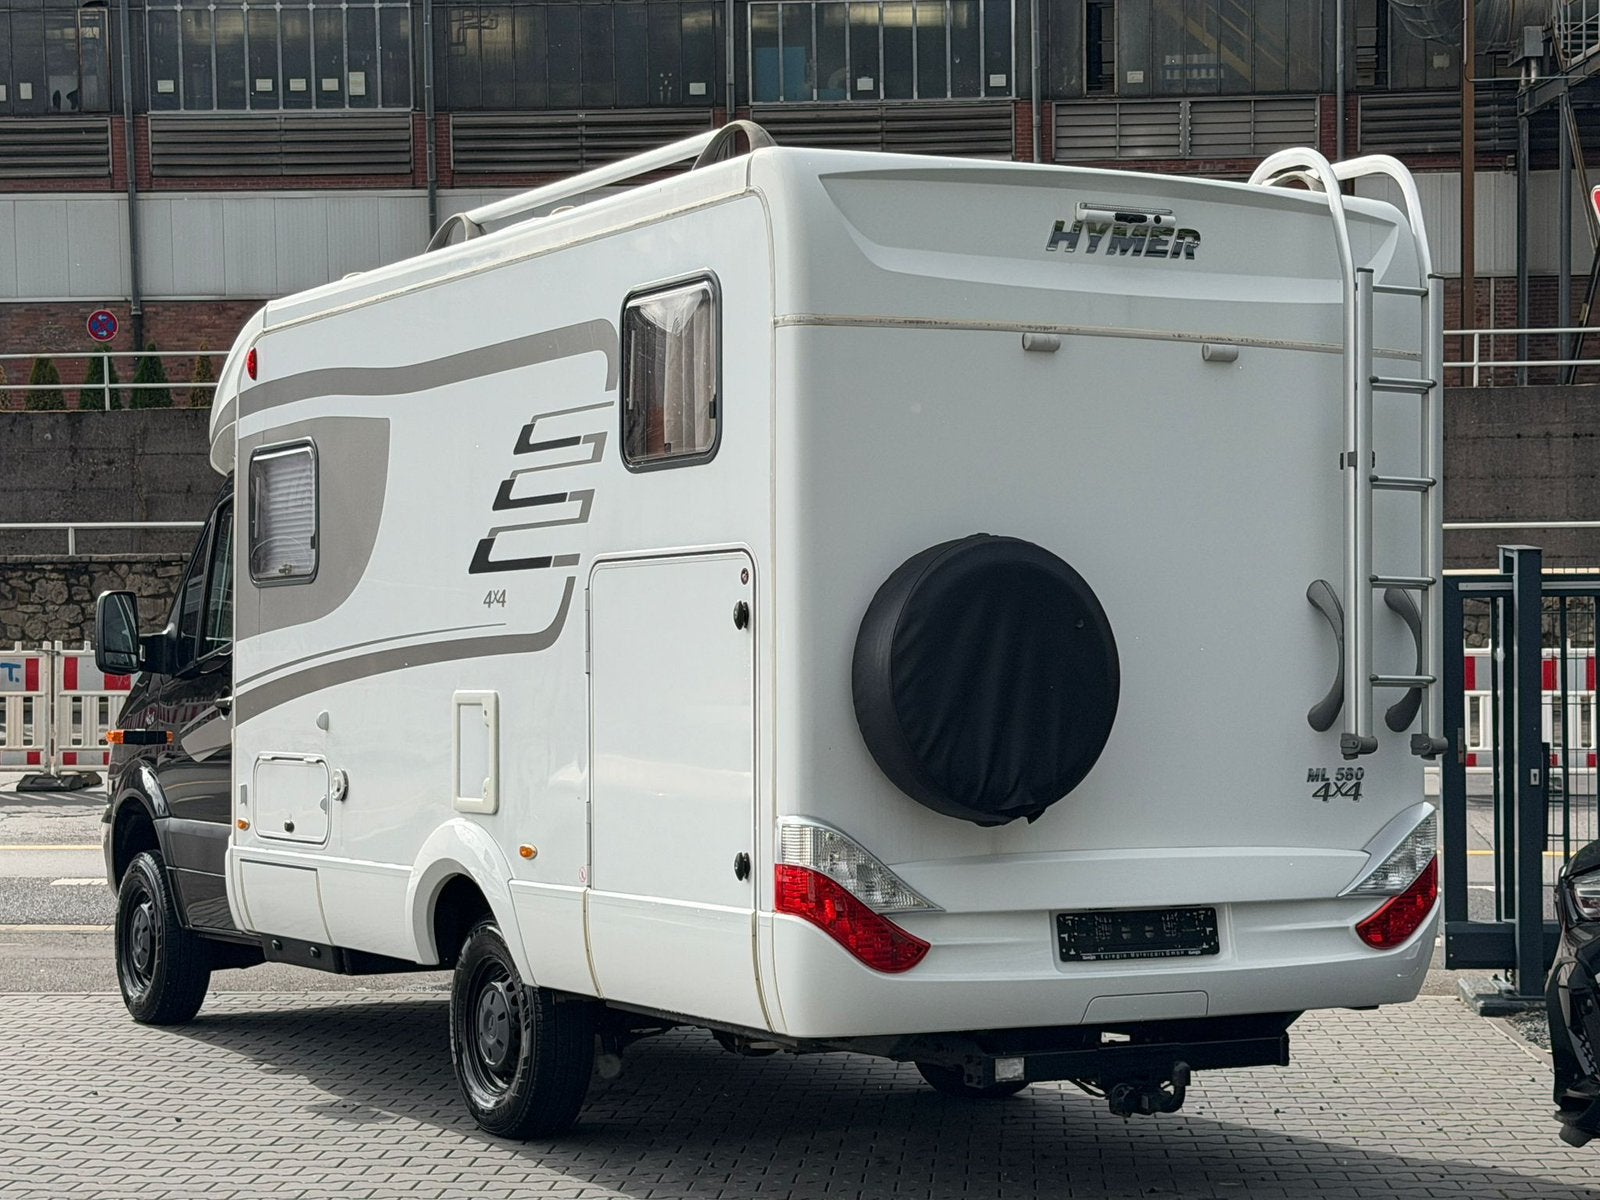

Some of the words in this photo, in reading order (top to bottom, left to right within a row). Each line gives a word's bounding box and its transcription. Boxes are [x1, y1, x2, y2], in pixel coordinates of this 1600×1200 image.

[1046, 219, 1201, 260] HYMER
[1306, 767, 1330, 782] ML
[1334, 766, 1365, 781] 580
